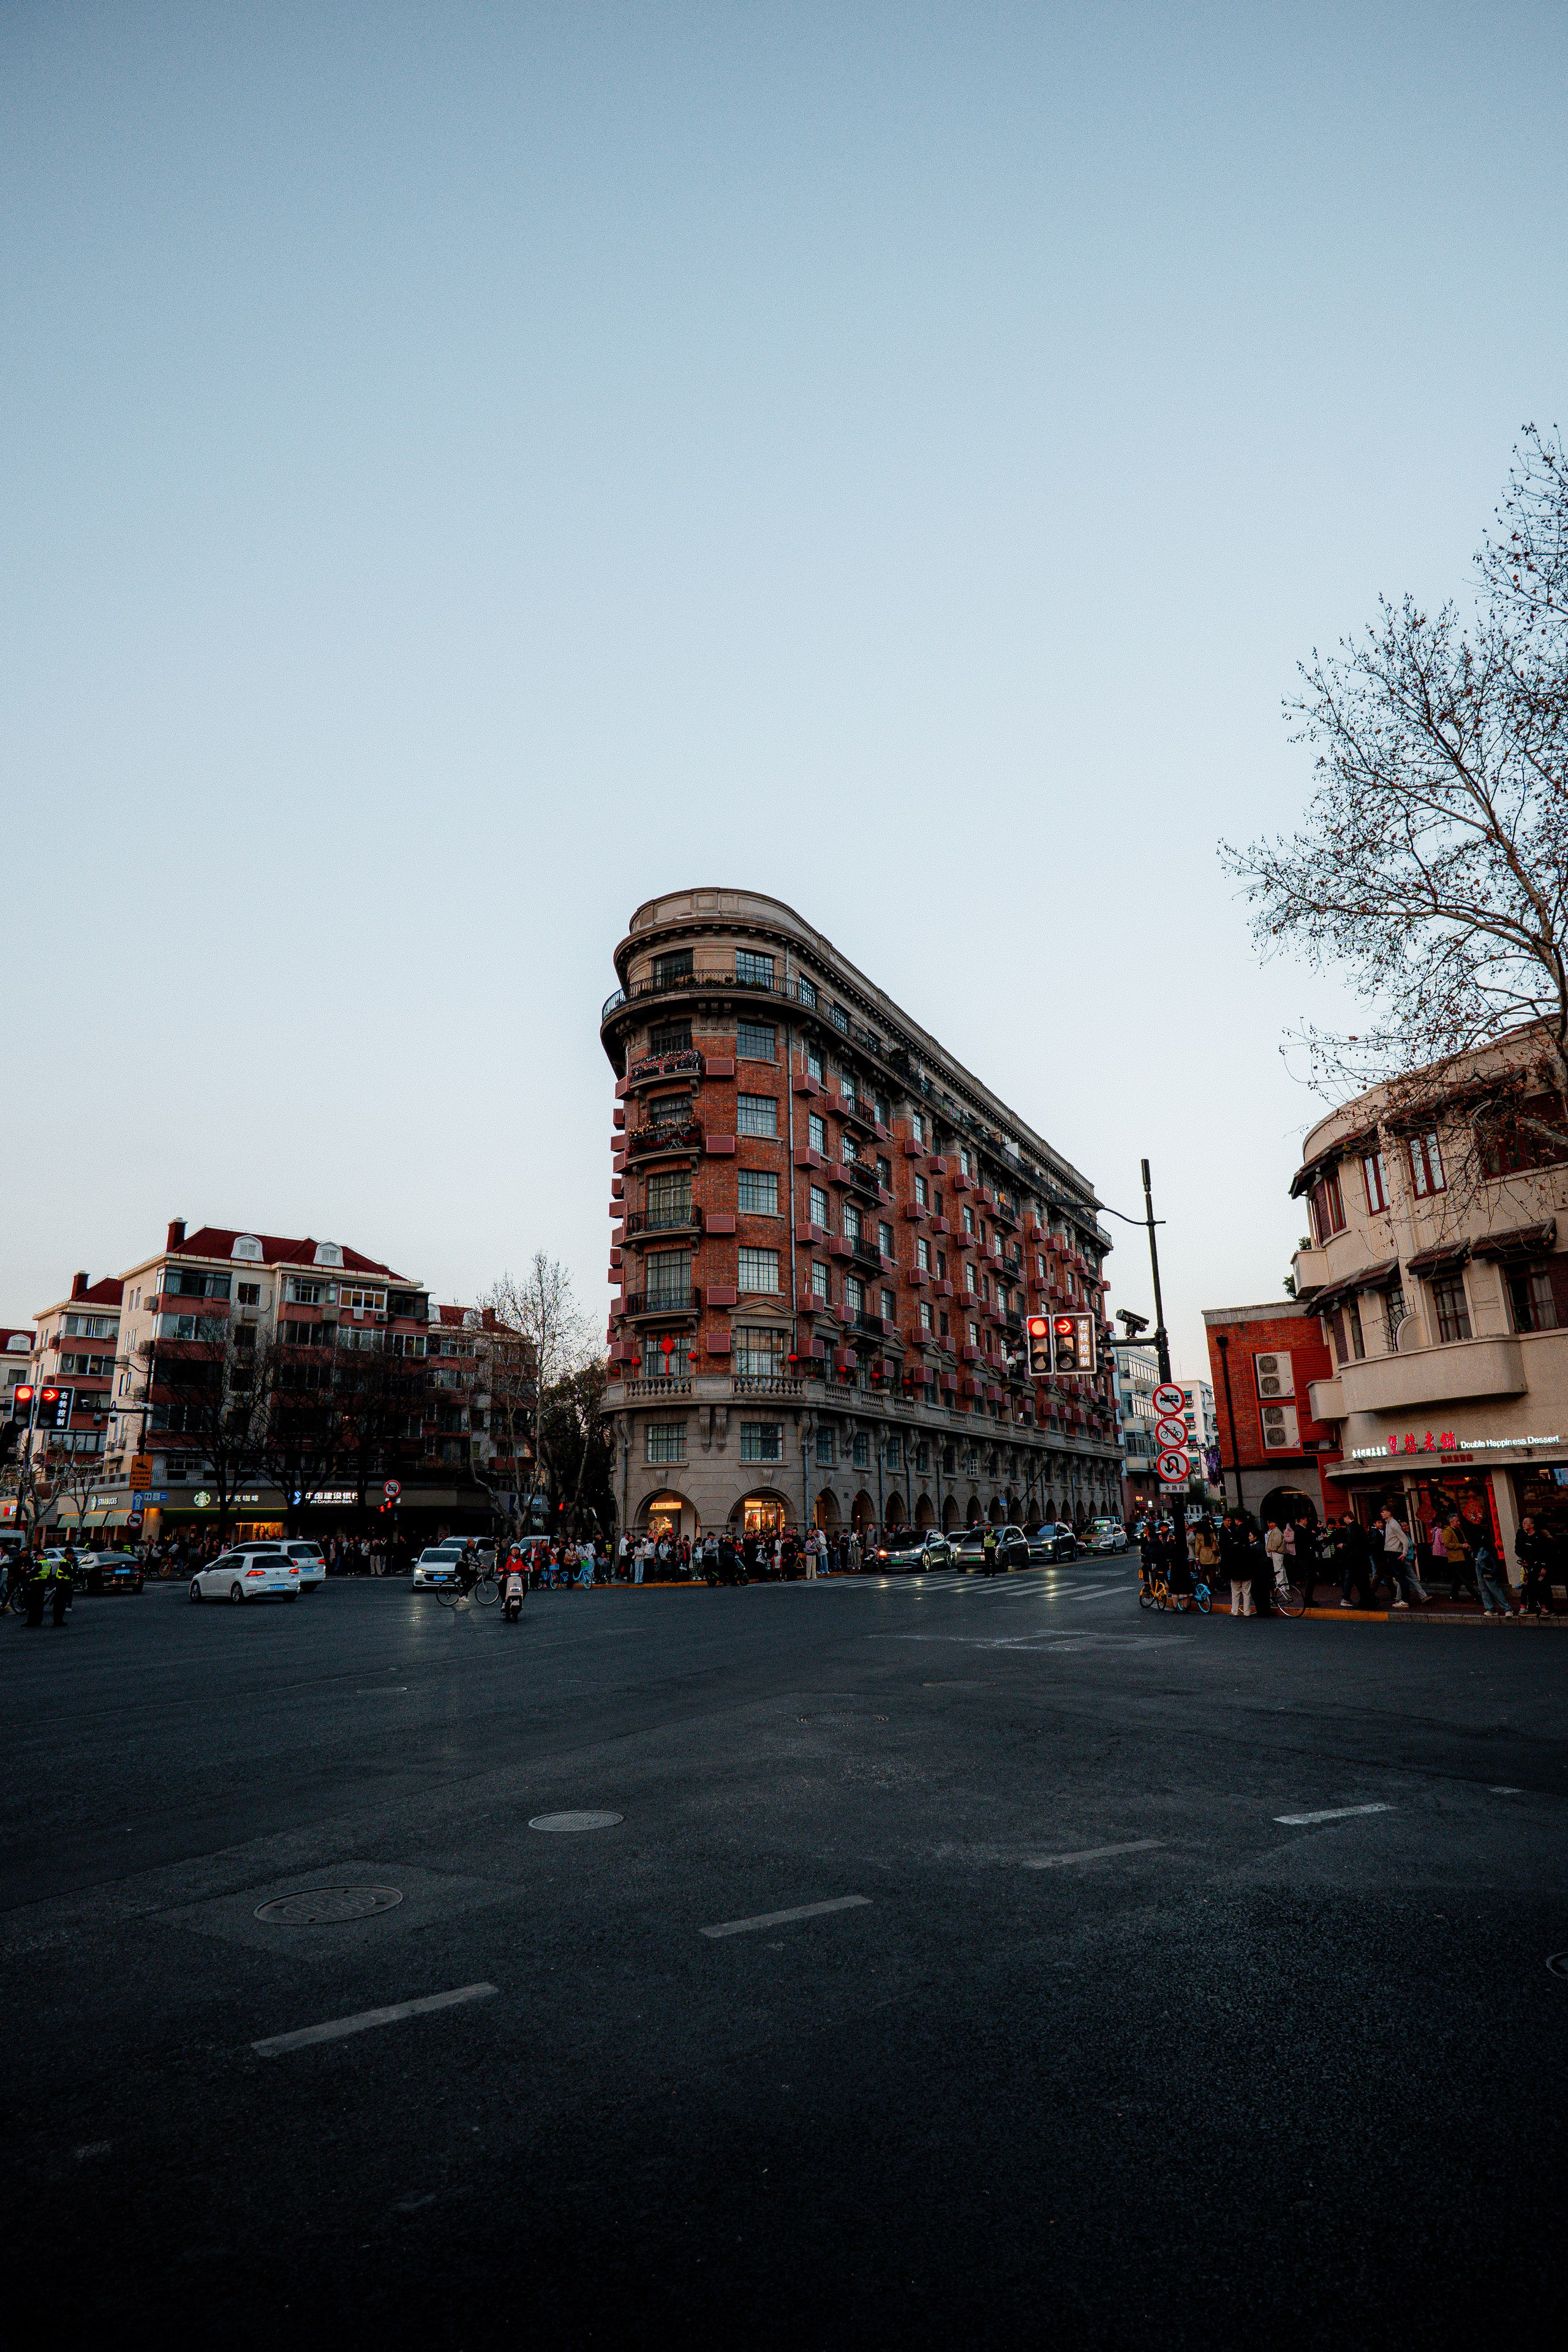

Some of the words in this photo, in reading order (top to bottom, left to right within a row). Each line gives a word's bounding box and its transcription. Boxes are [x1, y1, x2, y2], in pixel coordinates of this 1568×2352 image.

[1079, 1320, 1090, 1366] 右转控制
[56, 1392, 69, 1426] 右转控制
[1460, 1440, 1486, 1449] Double
[1486, 1438, 1527, 1449] Happiness
[1527, 1435, 1560, 1444] Dessert
